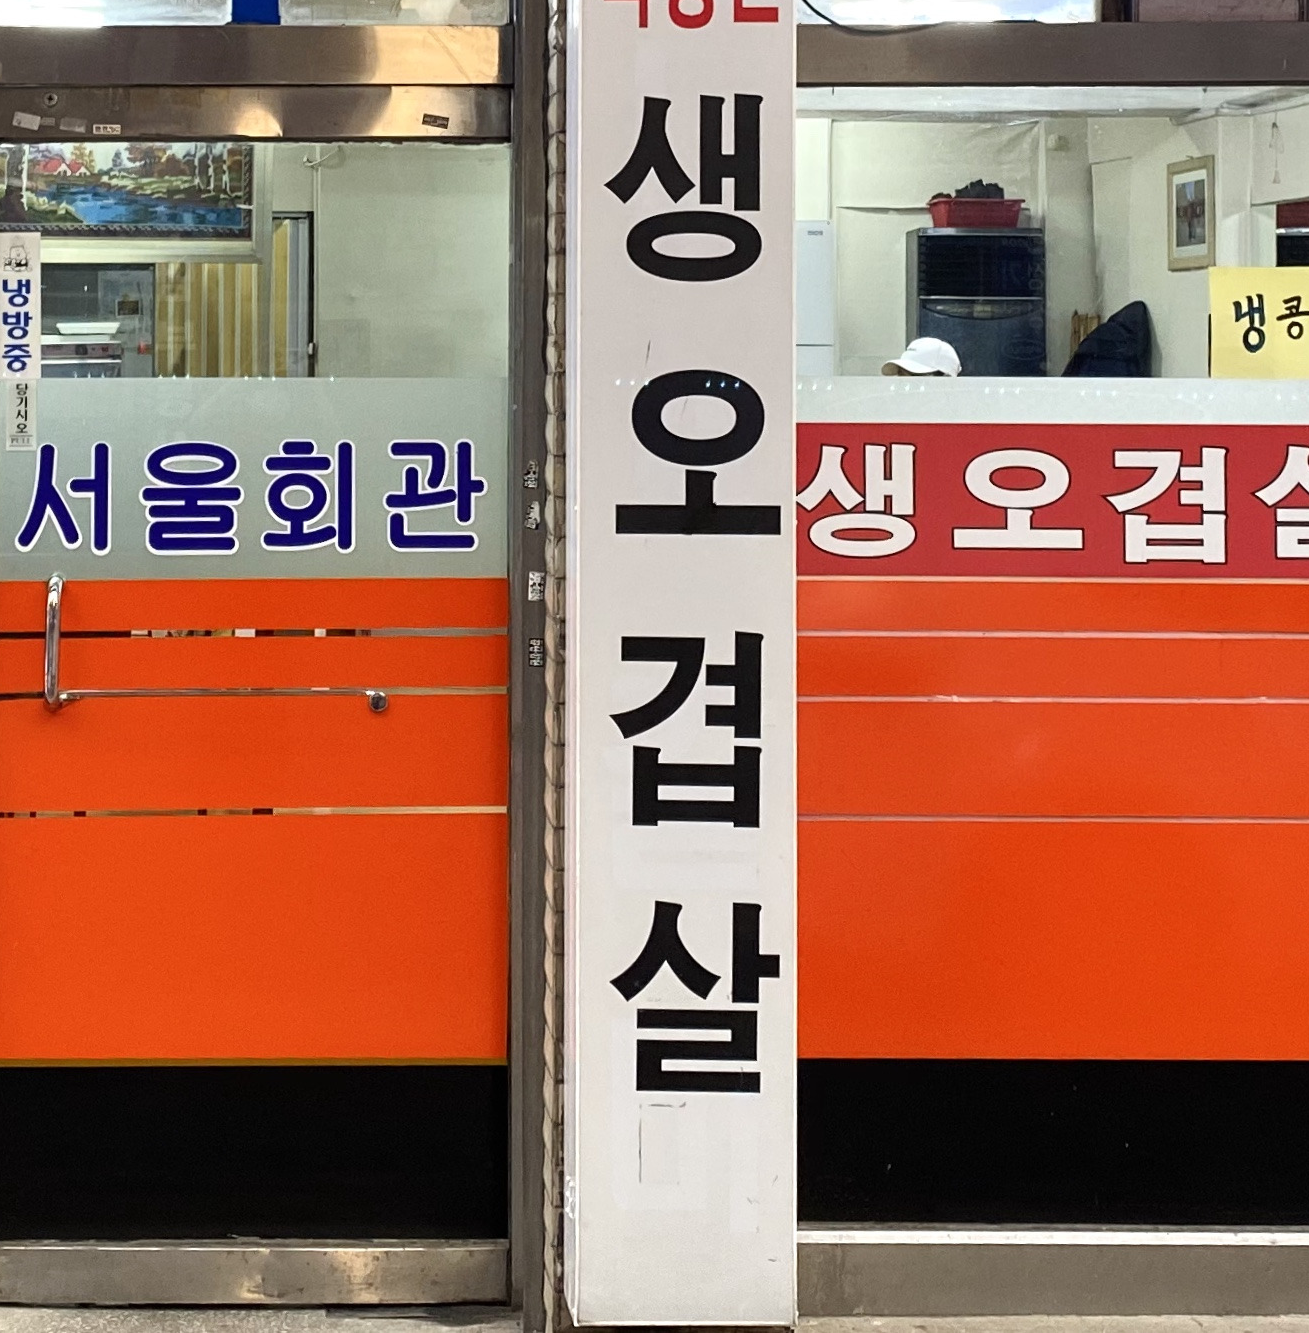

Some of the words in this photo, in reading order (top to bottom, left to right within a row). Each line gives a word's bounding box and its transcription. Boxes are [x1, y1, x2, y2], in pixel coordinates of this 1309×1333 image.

[1, 278, 34, 373] 냉방중
[15, 383, 29, 434] 당기시오
[14, 438, 489, 556] 서울회관
[603, 93, 782, 1093] 생오겹살
